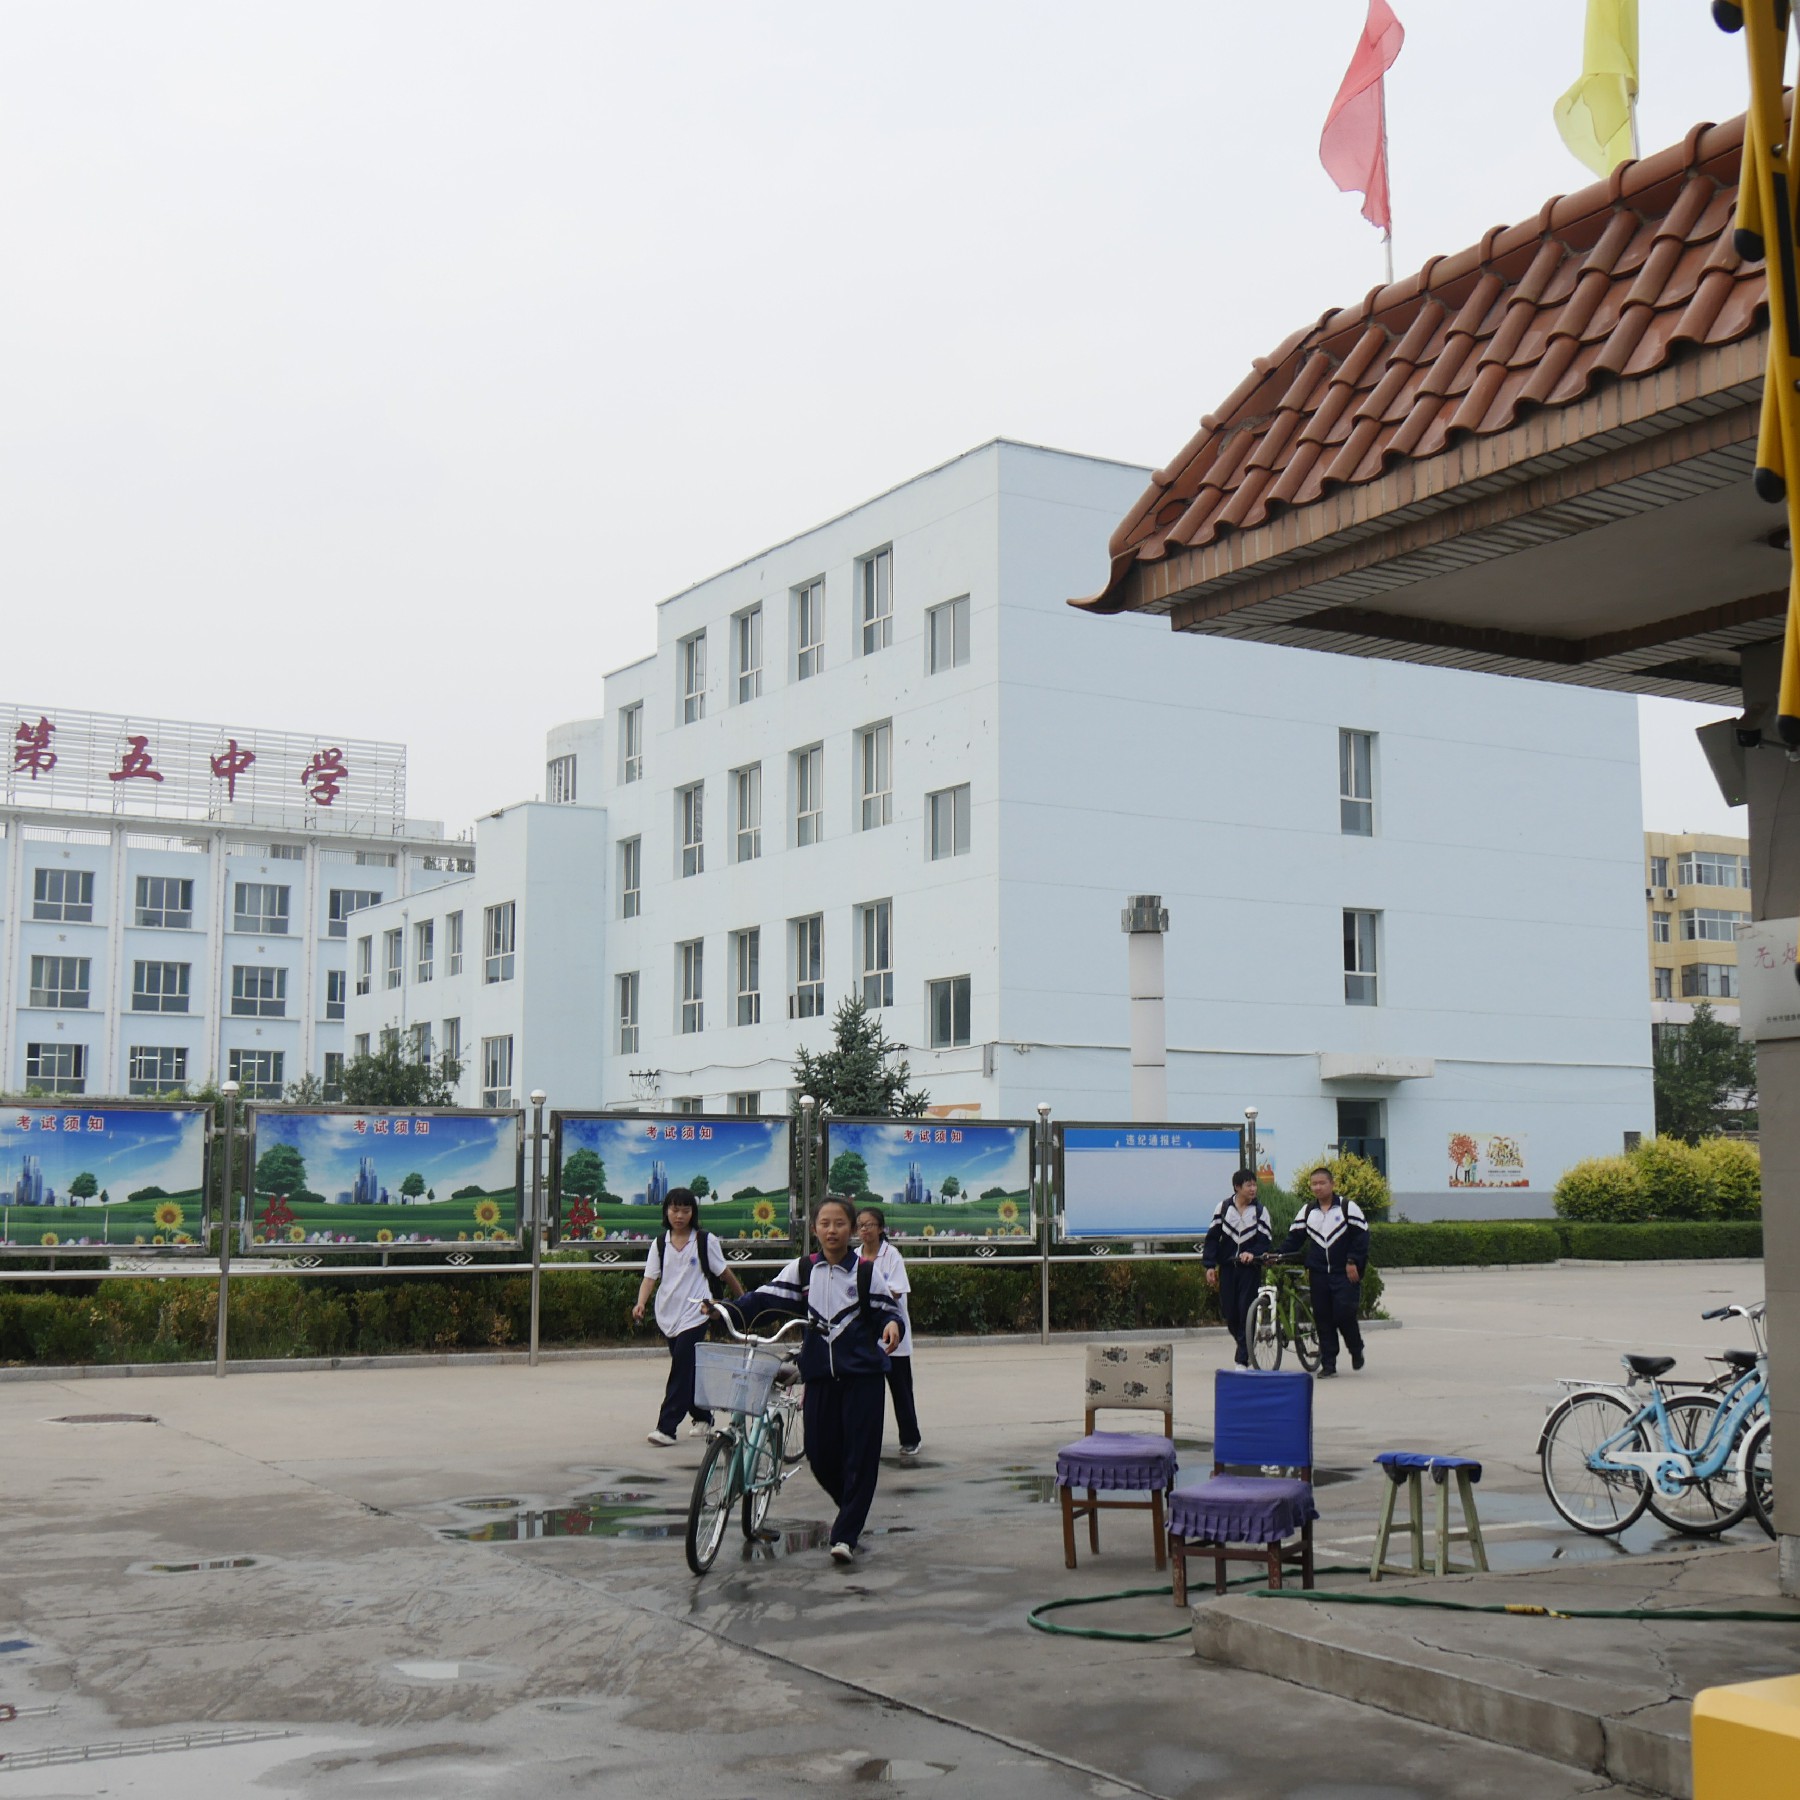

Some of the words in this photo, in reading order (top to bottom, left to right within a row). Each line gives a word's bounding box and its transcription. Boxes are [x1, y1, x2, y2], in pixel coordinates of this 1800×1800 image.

[11, 716, 348, 805] 第五中学
[16, 1114, 104, 1131] 考试须知
[353, 1119, 430, 1135] 考试须知
[645, 1125, 712, 1140] 考试须知
[903, 1128, 962, 1143] 考试须知
[1126, 1134, 1181, 1147] 违纪通报栏
